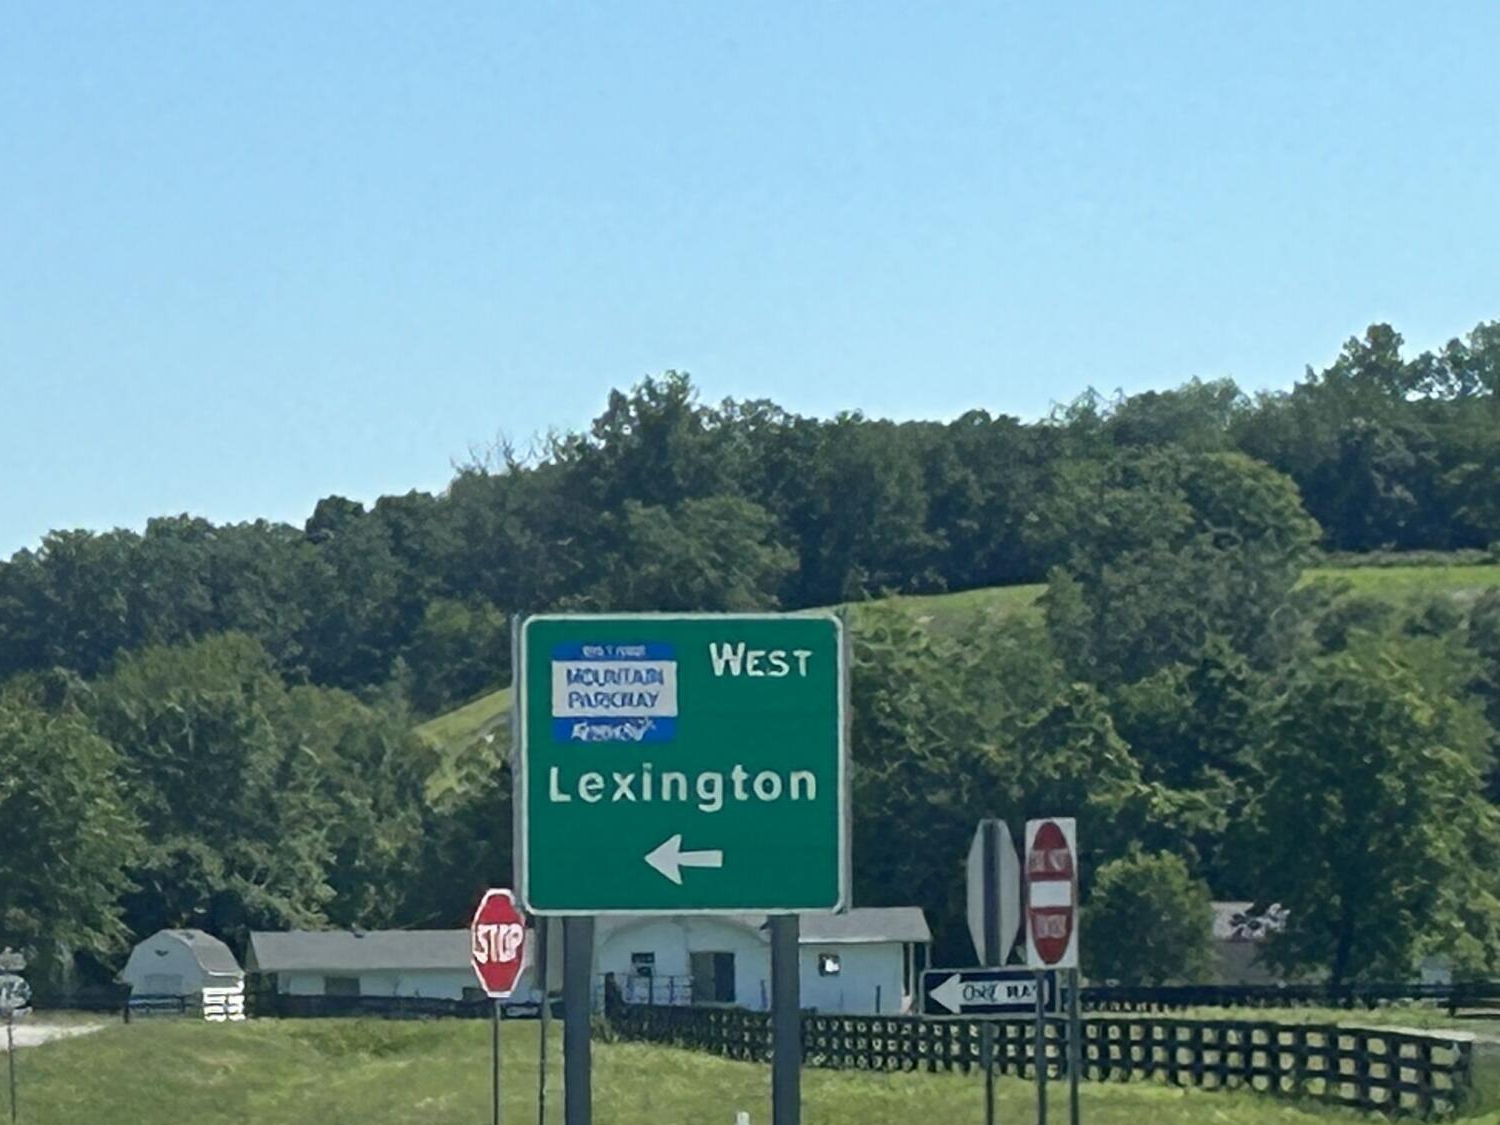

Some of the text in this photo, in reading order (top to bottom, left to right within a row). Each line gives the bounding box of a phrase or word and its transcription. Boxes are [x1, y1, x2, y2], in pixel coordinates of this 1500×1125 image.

[709, 642, 813, 677] WEST
[549, 762, 817, 812] Lexington
[473, 923, 524, 965] STOP
